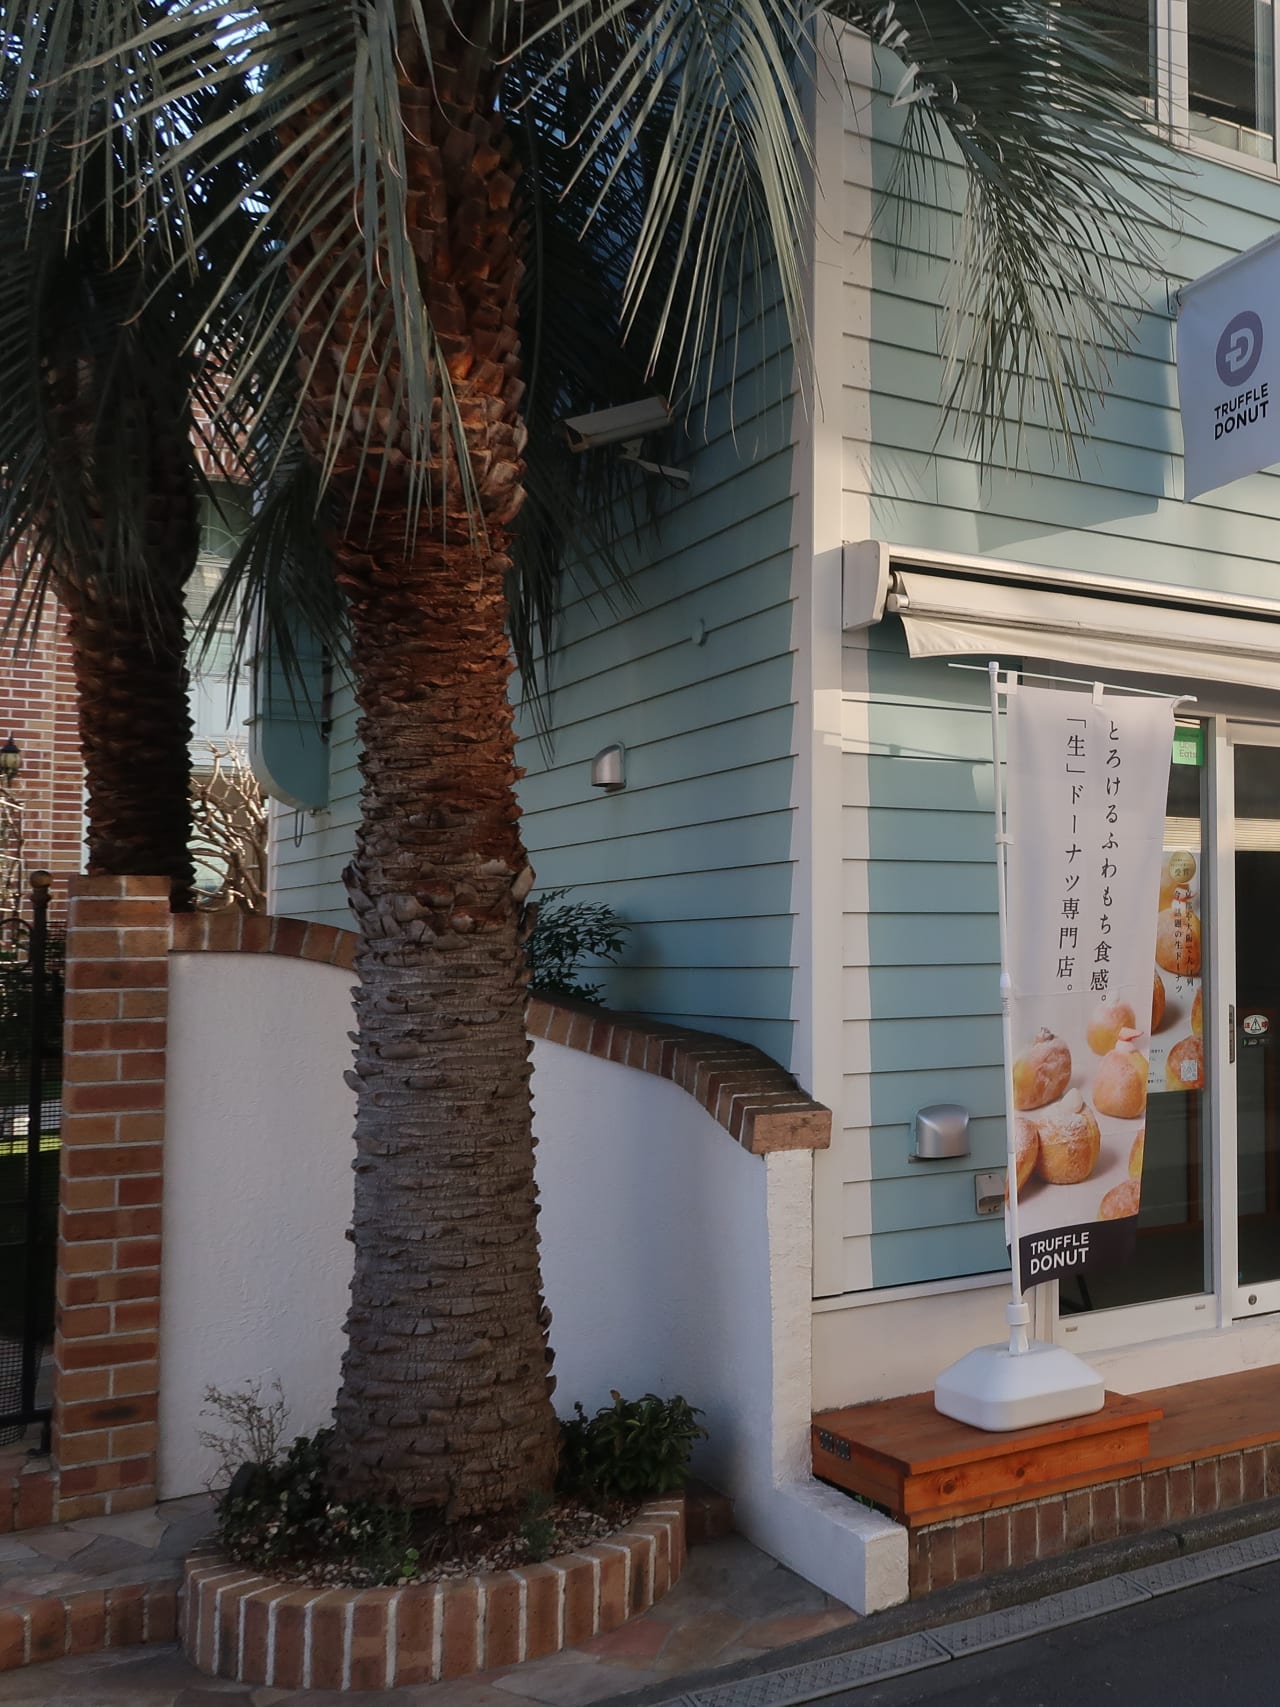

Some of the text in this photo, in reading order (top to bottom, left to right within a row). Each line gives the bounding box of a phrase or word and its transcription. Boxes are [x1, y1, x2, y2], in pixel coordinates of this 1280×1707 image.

[1214, 383, 1269, 420] TRUFFLE
[1214, 400, 1269, 441] DONUT
[1056, 718, 1087, 992] 「生」ドーナツ専門店。
[1090, 720, 1121, 1002] とろけるふわもち食感。
[1030, 1231, 1090, 1256] TRUFFLE
[1030, 1247, 1089, 1275] DONUT
